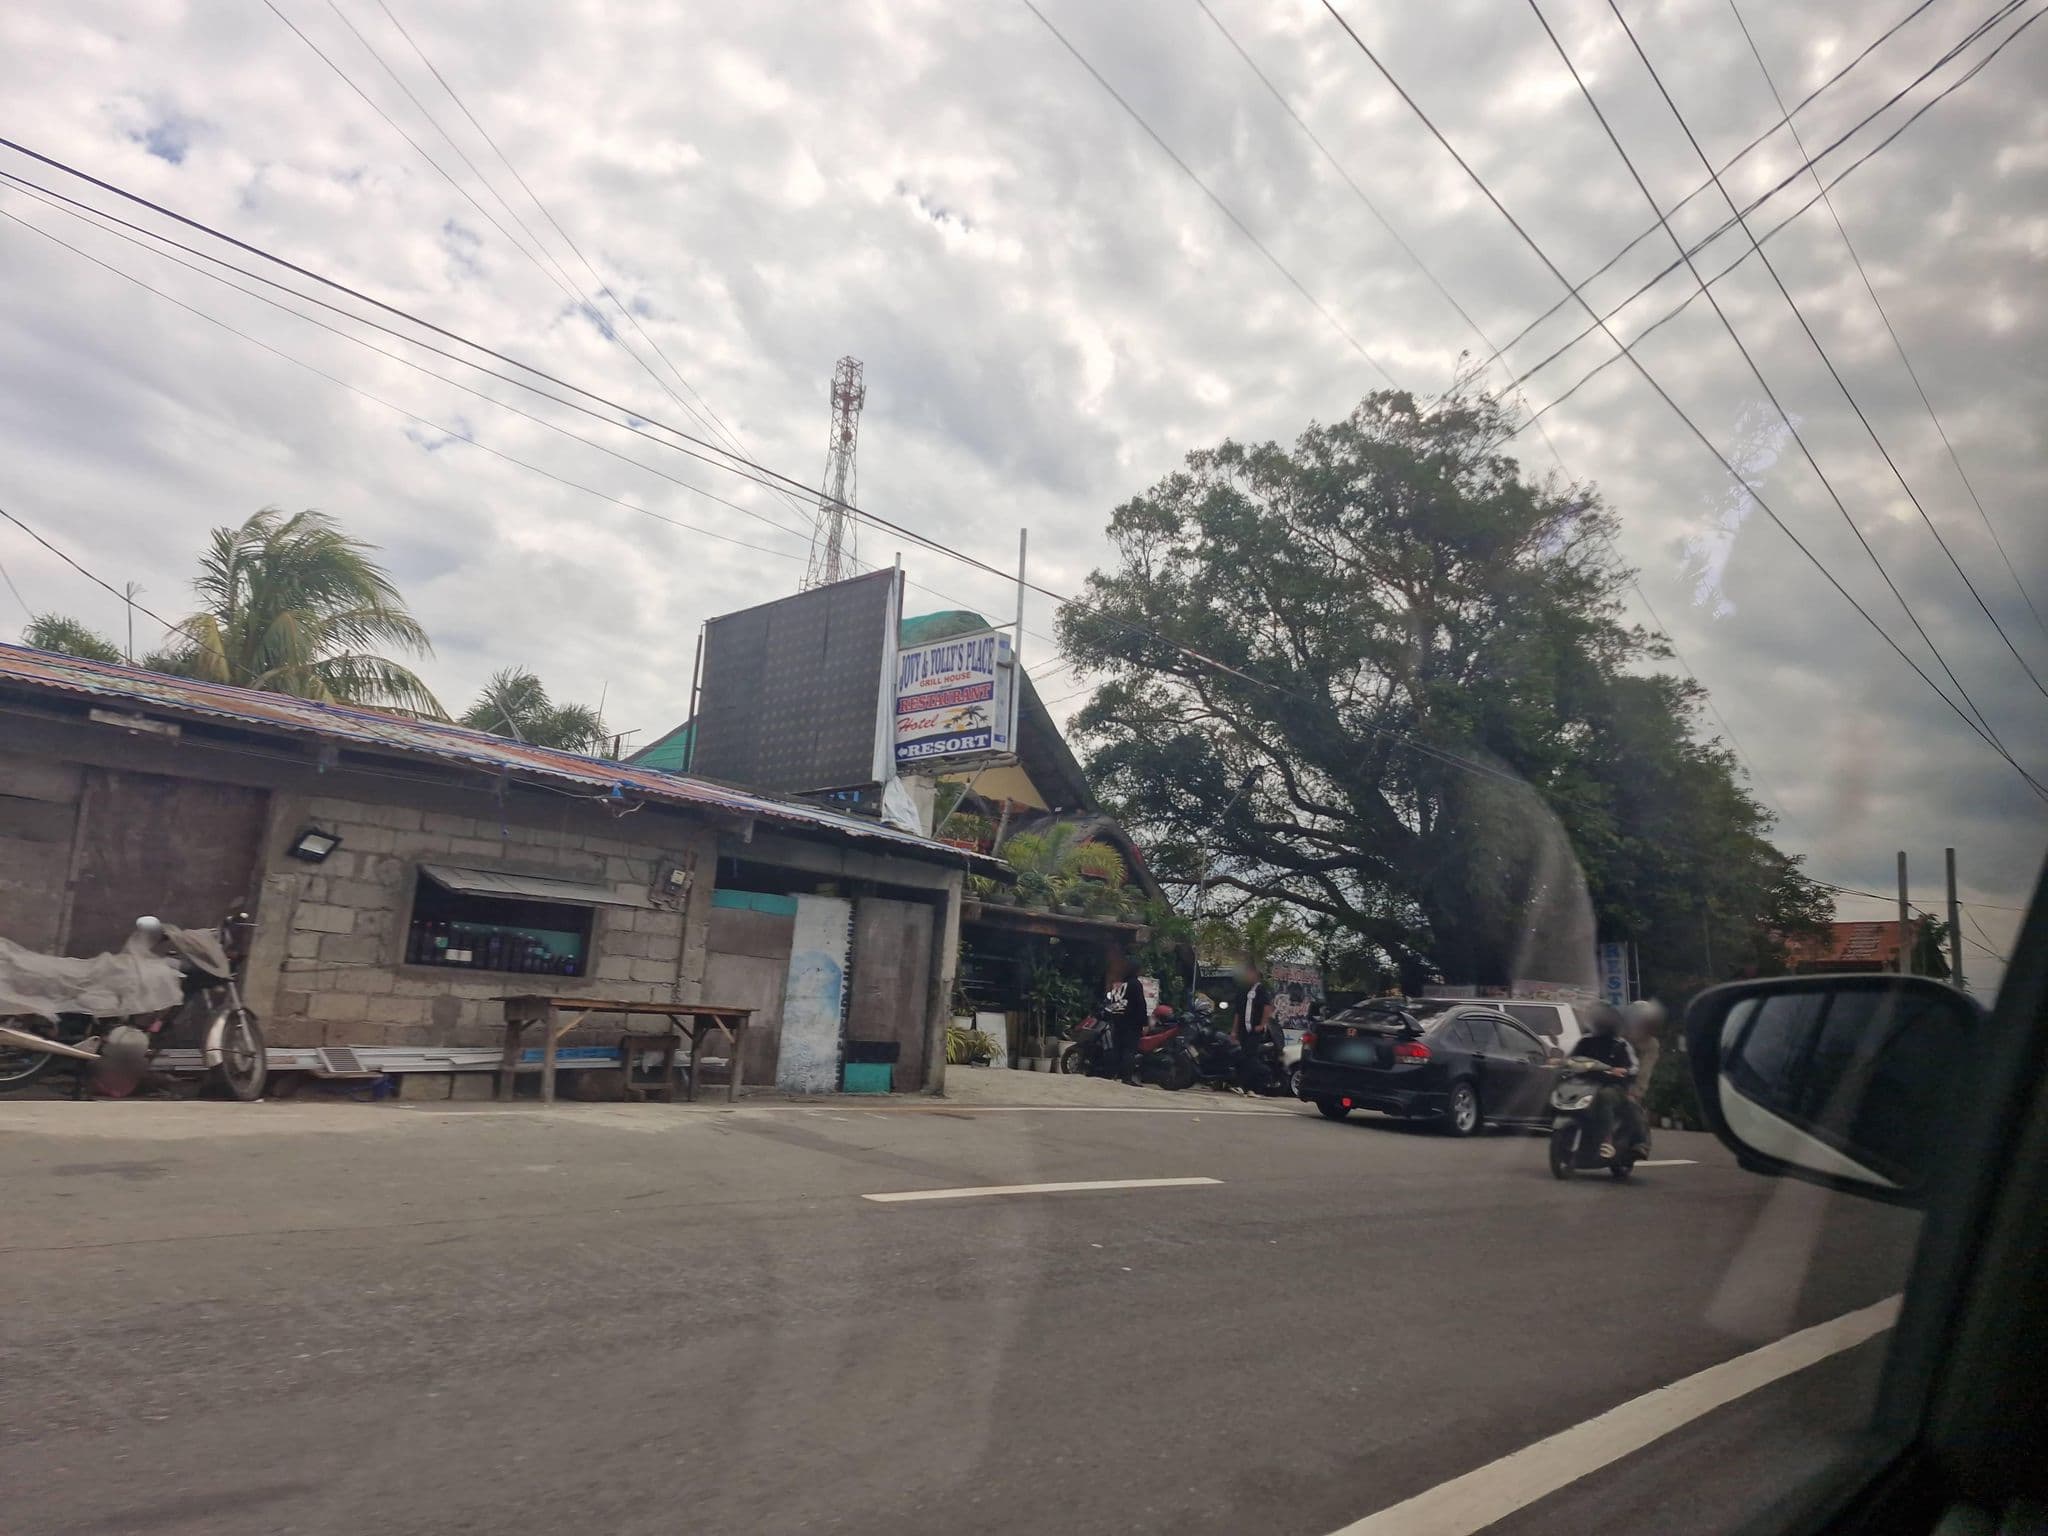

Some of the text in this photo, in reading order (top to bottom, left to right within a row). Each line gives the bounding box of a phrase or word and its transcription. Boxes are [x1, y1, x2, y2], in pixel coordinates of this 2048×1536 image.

[899, 638, 994, 692] JOVY & YOLLY'S PLACE
[920, 677, 942, 688] GRILL
[944, 671, 972, 684] HOUSE
[899, 684, 992, 713] RESTAURANT
[897, 713, 940, 733] Hotel
[907, 735, 988, 756] RESORT
